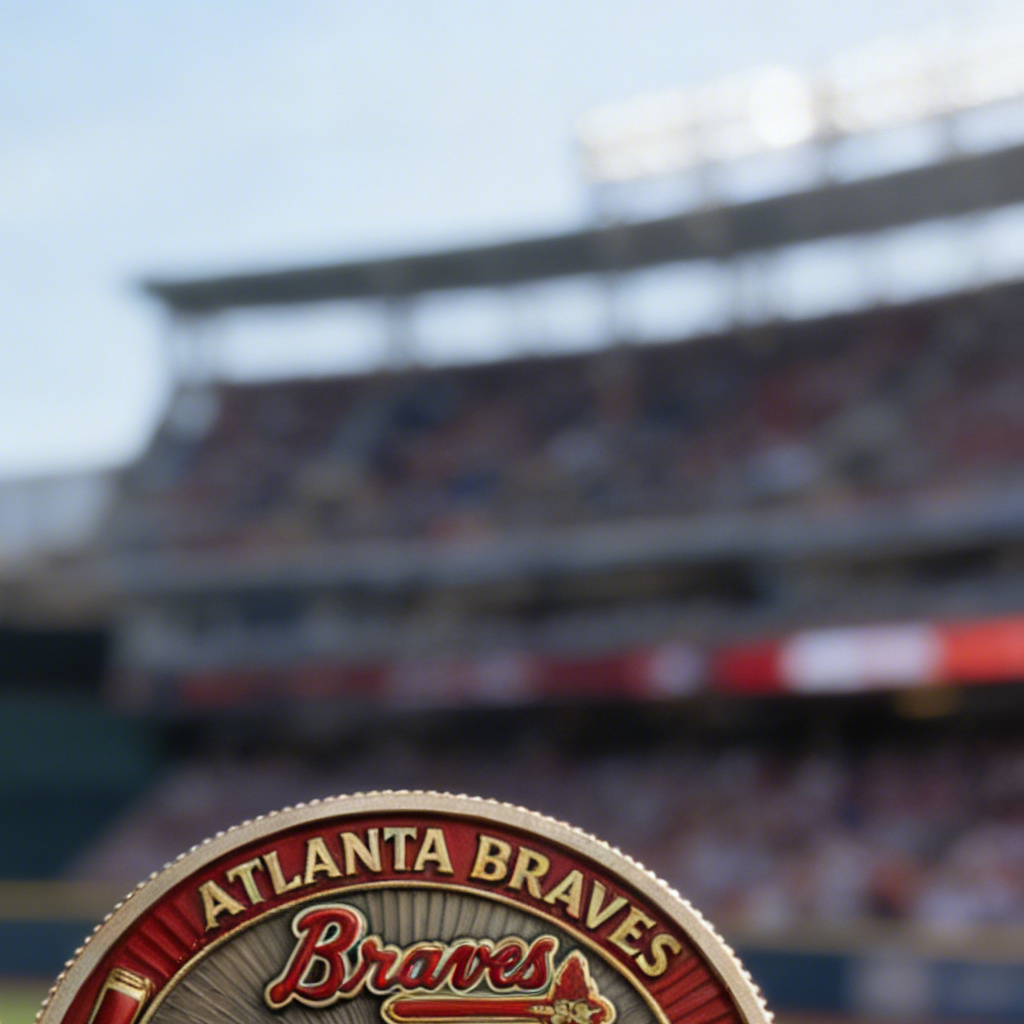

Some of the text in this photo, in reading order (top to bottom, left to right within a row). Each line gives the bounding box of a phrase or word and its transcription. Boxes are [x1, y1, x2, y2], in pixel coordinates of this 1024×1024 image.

[198, 826, 683, 979] ATLANTA BRAVES
[265, 903, 559, 1008] Braves
